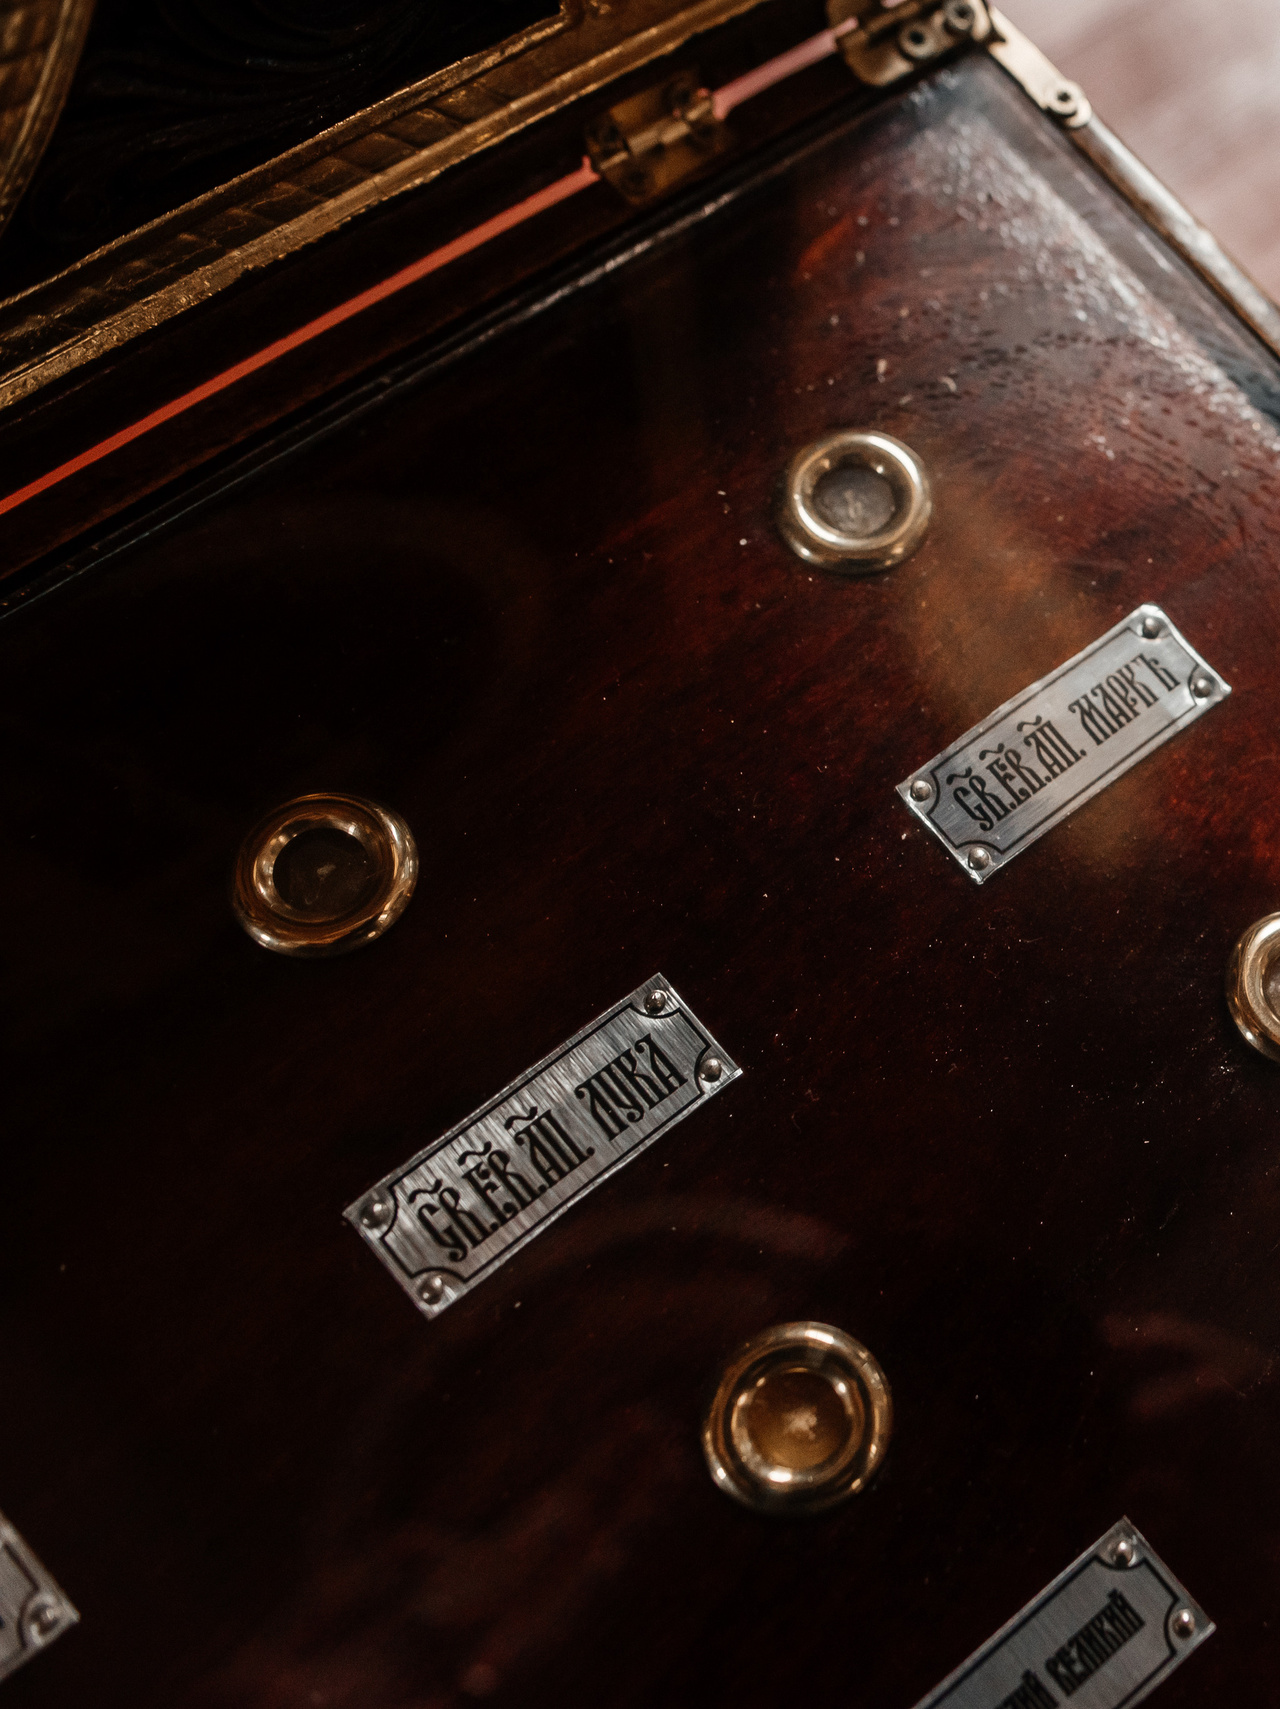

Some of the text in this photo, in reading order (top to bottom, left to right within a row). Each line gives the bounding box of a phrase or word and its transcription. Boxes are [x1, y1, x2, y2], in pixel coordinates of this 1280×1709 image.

[1068, 653, 1181, 746] МАРКЪ
[574, 1033, 688, 1141] ЛУКА
[1045, 1588, 1145, 1697] ВЕЛИКИЙ
